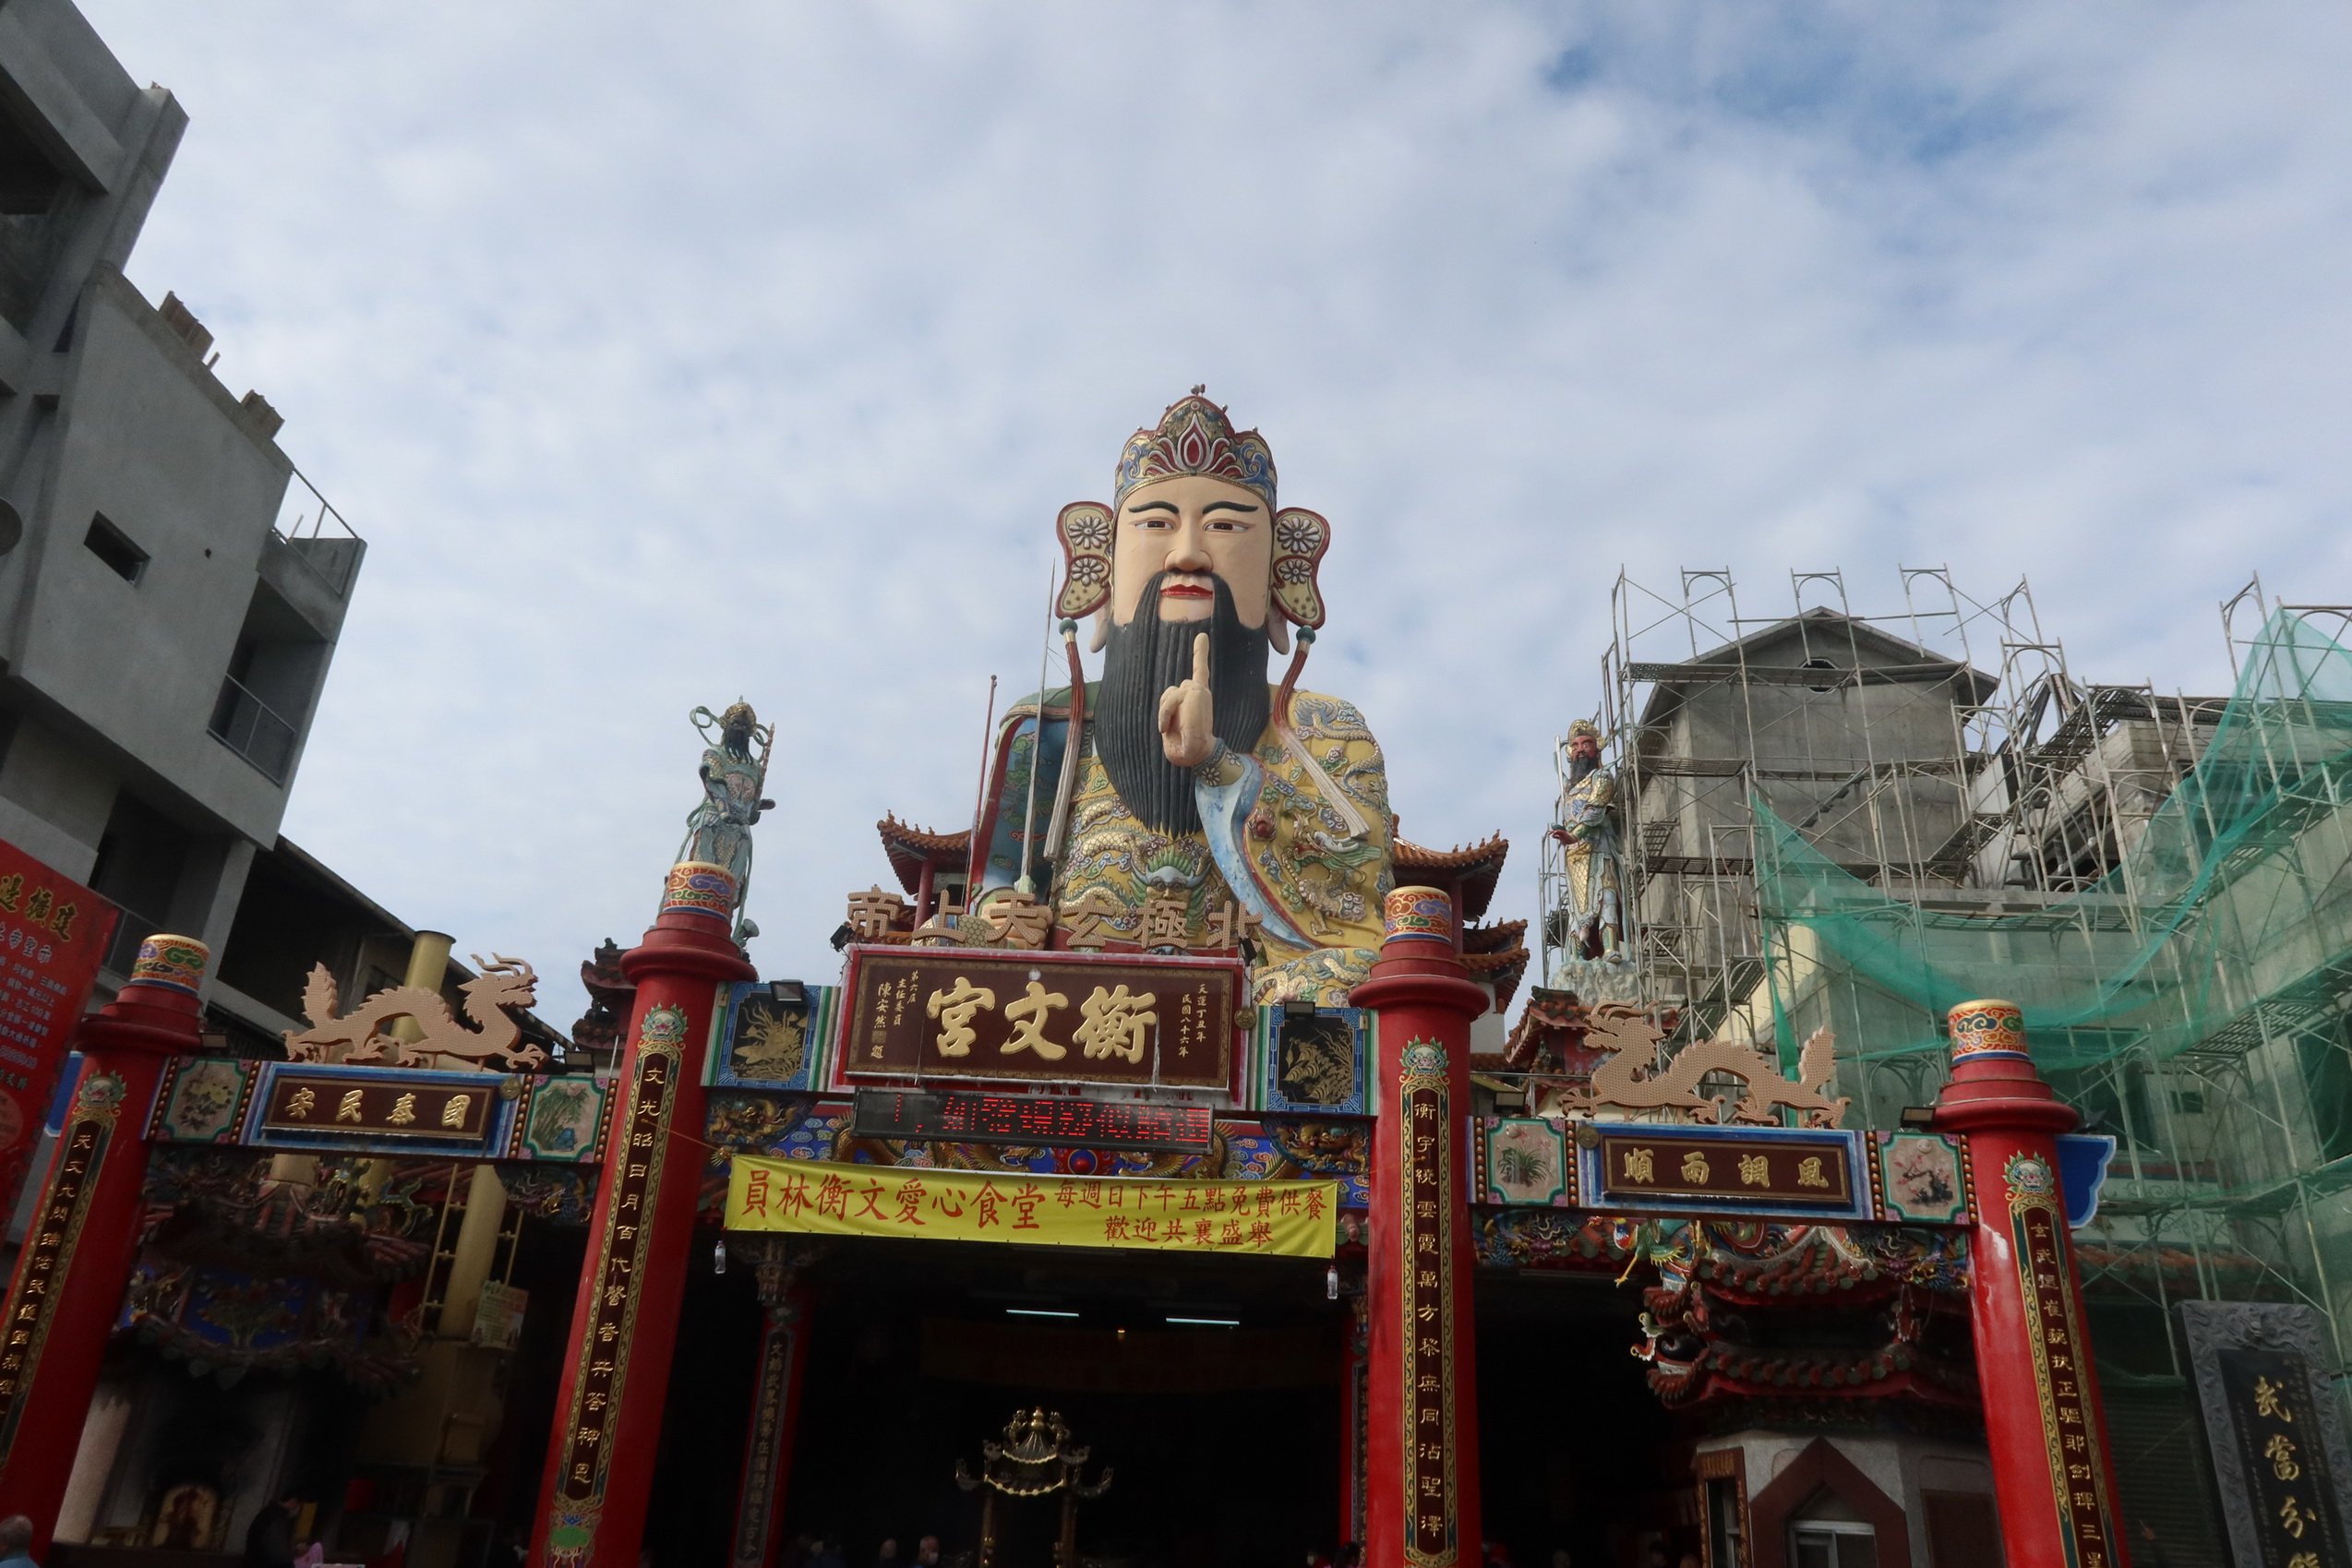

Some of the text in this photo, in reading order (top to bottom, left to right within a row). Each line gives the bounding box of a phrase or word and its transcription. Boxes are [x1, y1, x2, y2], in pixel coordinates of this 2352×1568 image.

[1178, 993, 1193, 1058] 民國八十六年
[740, 1169, 1047, 1230] 員林衡文愛心食堂
[1054, 1178, 1329, 1221] 每週日下午五點免費供餐
[1103, 1215, 1275, 1249] 歡迎共襄盛舉
